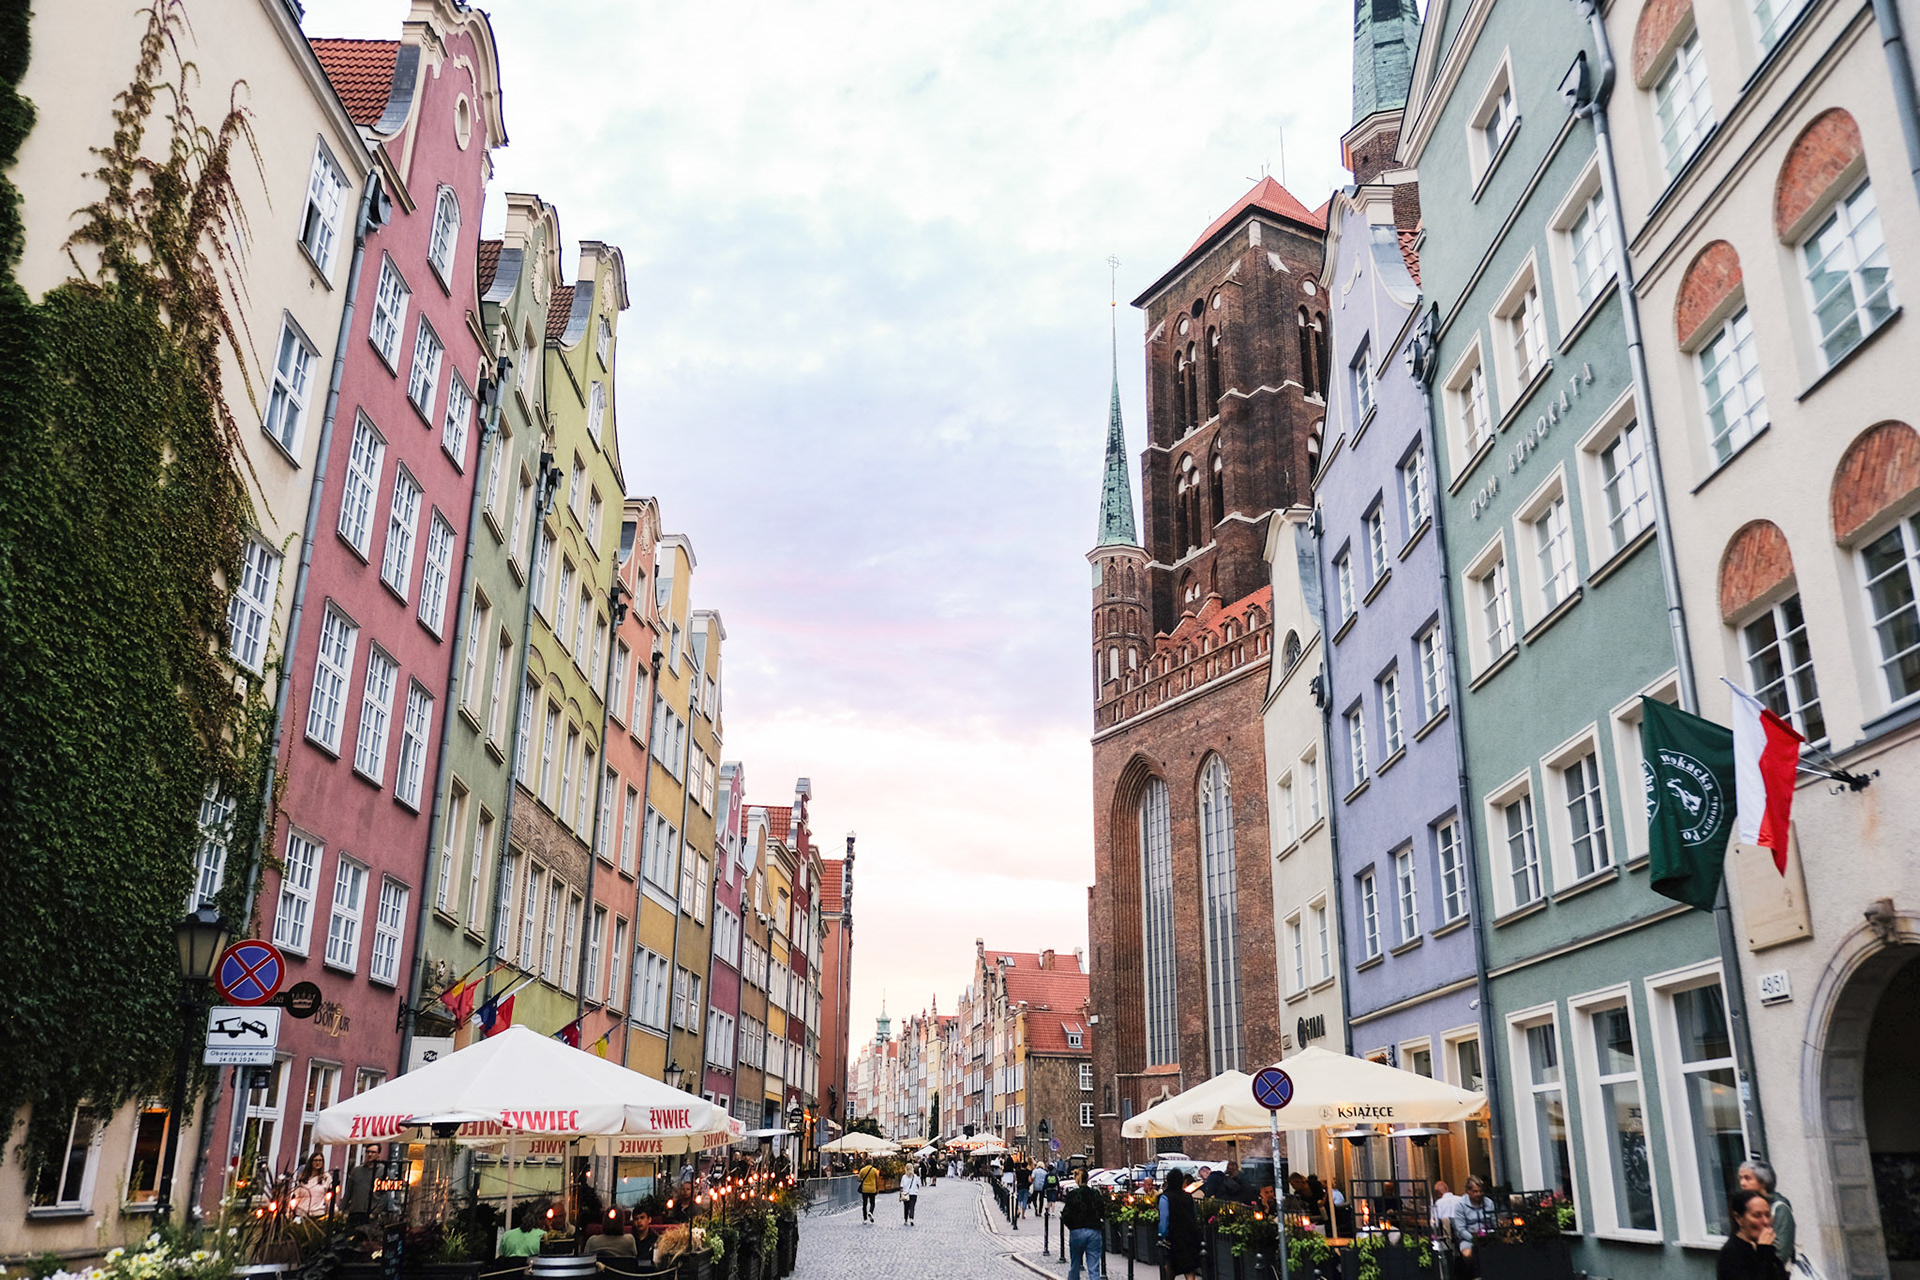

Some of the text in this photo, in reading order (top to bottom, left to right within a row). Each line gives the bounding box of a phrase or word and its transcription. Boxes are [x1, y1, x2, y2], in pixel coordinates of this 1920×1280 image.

[1470, 474, 1499, 519] DOM
[500, 1108, 579, 1131] ŻYWIEC
[650, 1107, 692, 1130] ŻYWIEC
[1337, 1104, 1394, 1120] KSIĄŻĘCE
